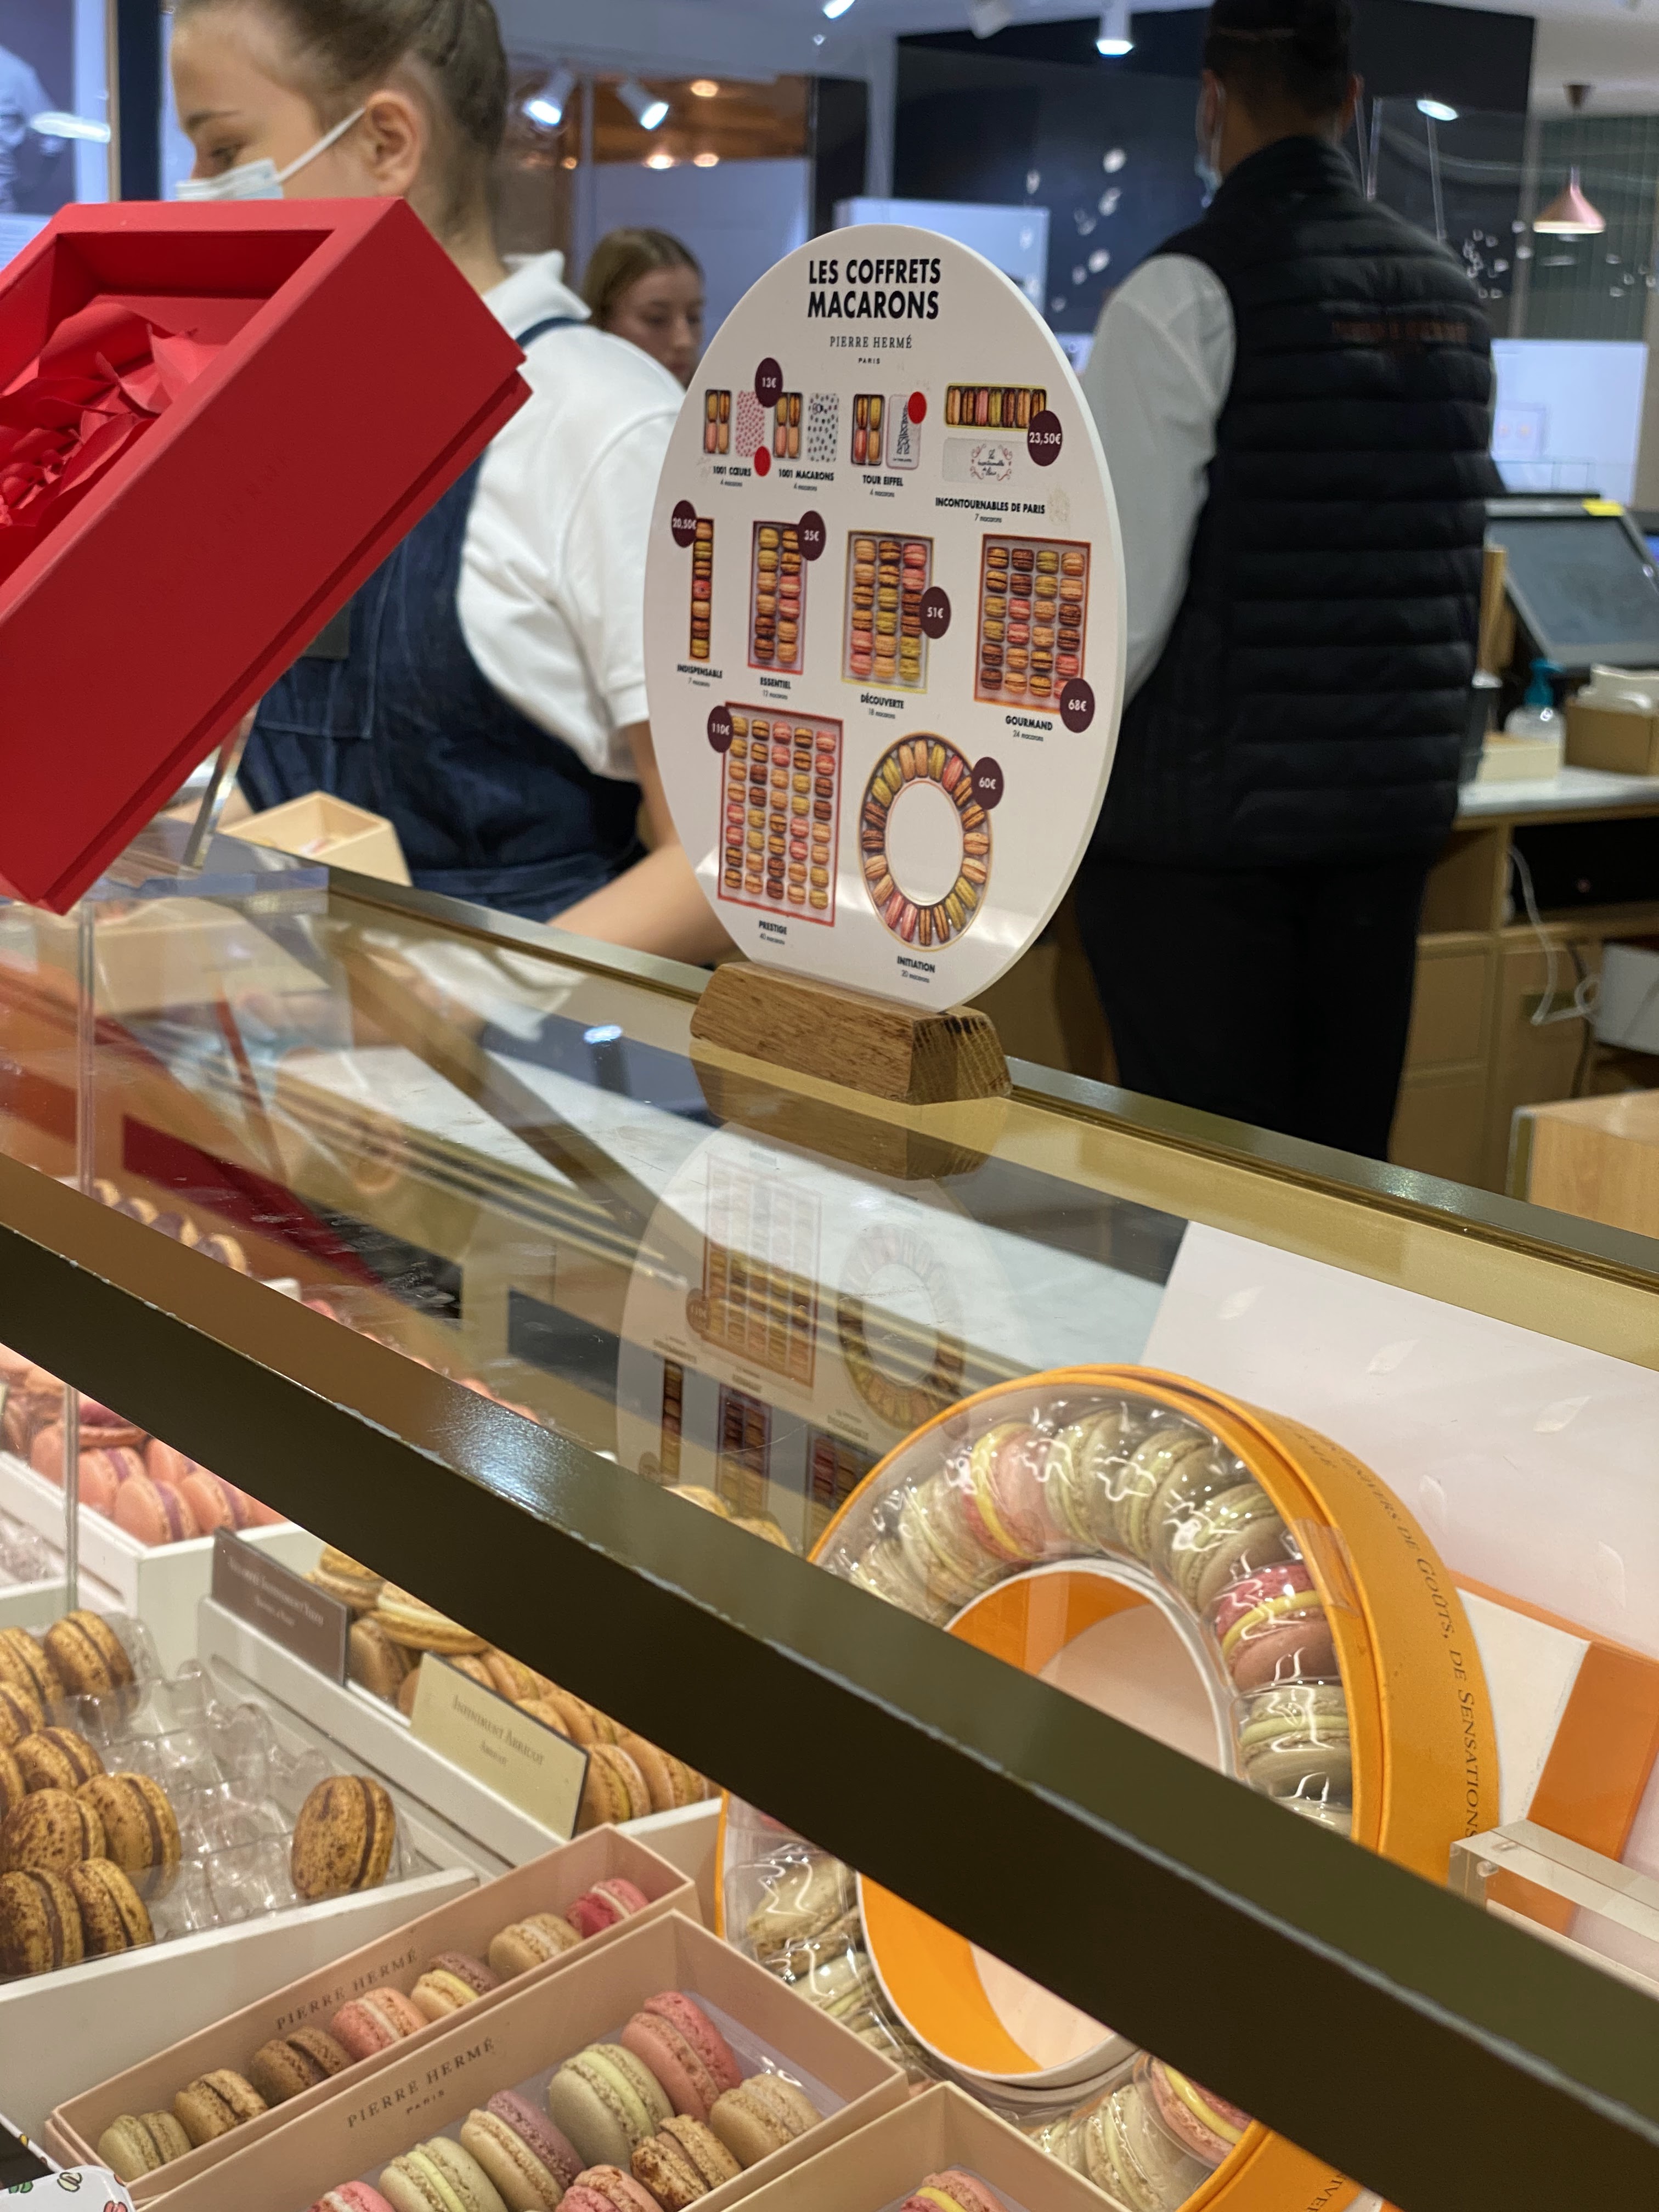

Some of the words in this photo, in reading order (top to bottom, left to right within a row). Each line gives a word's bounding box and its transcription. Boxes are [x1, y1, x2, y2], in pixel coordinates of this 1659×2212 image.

[809, 259, 839, 284] LES
[846, 258, 941, 284] COFFRETS
[808, 290, 940, 320] MACARONS
[830, 336, 869, 347] PIERRE
[873, 334, 912, 349] HERMÉ
[761, 377, 777, 388] 13€
[1029, 431, 1062, 445] 23,50€
[713, 466, 727, 476] 1001
[778, 469, 793, 478] 1001
[795, 470, 834, 482] MACARONS
[862, 474, 881, 485] TOUR
[883, 476, 904, 487] EIFFEL
[935, 496, 1009, 512] INCONTOURNABLES
[1011, 503, 1021, 513] DE
[1023, 503, 1046, 515] PARIS
[803, 529, 820, 541] 35€
[926, 606, 944, 619] 51€
[676, 663, 723, 679] INDISPENSABLE
[760, 676, 792, 690] ESSENTIEL
[860, 692, 905, 709] DÉCOUVERTE
[1068, 698, 1087, 712] 68€
[711, 722, 730, 736] 110€
[1005, 715, 1053, 731] GOURMAND
[978, 776, 996, 790] 60€
[759, 919, 787, 935] PRESTIGE
[897, 955, 936, 974] INITIATION
[1448, 1649, 1468, 1682] DE
[1457, 1689, 1479, 1838] SENSATIONS
[276, 1985, 345, 2030] PIERRE
[347, 2079, 419, 2129] PIERRE
[425, 2036, 495, 2085] HERMÉ
